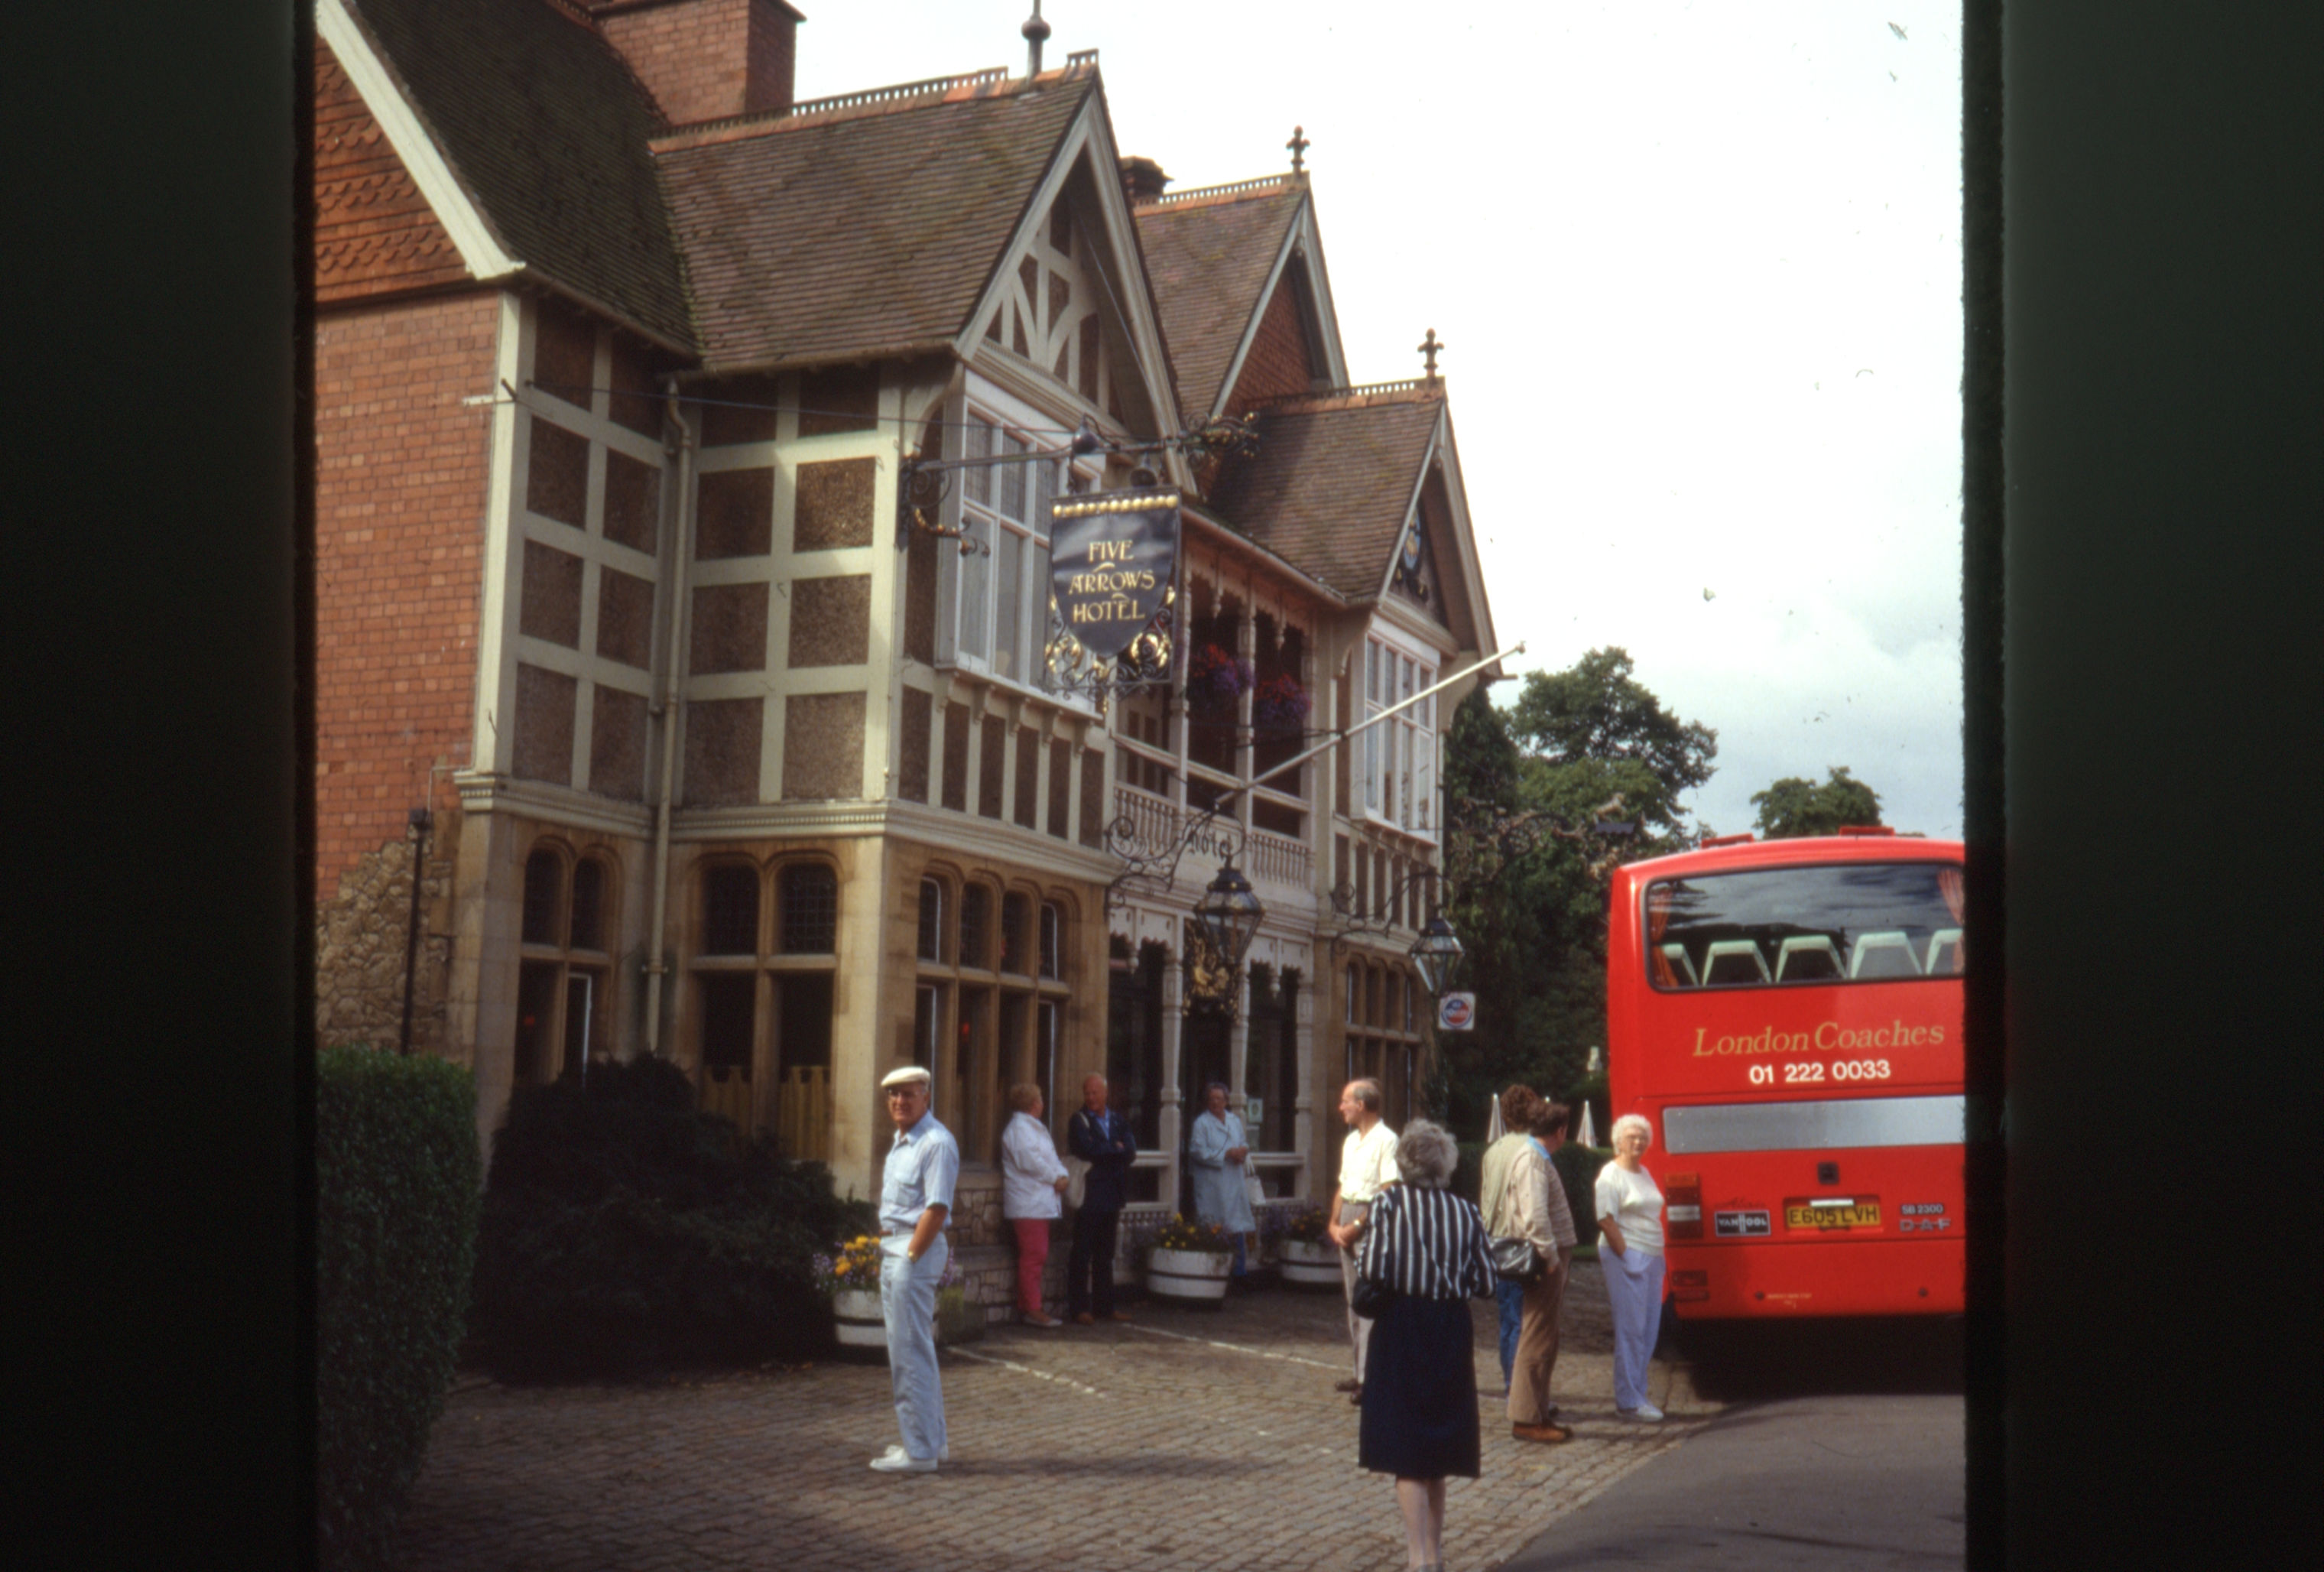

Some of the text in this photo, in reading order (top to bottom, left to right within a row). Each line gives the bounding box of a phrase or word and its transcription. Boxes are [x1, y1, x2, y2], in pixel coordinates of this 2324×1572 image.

[1088, 539, 1134, 563] FIVE
[1068, 569, 1156, 596] ARROWS
[1073, 599, 1146, 623] HOTEL
[1693, 1019, 1946, 1057] London Coaches
[1748, 1058, 1892, 1085] 01 222 0033
[1841, 1206, 1878, 1223] LVH
[1917, 1203, 1945, 1215] 2300
